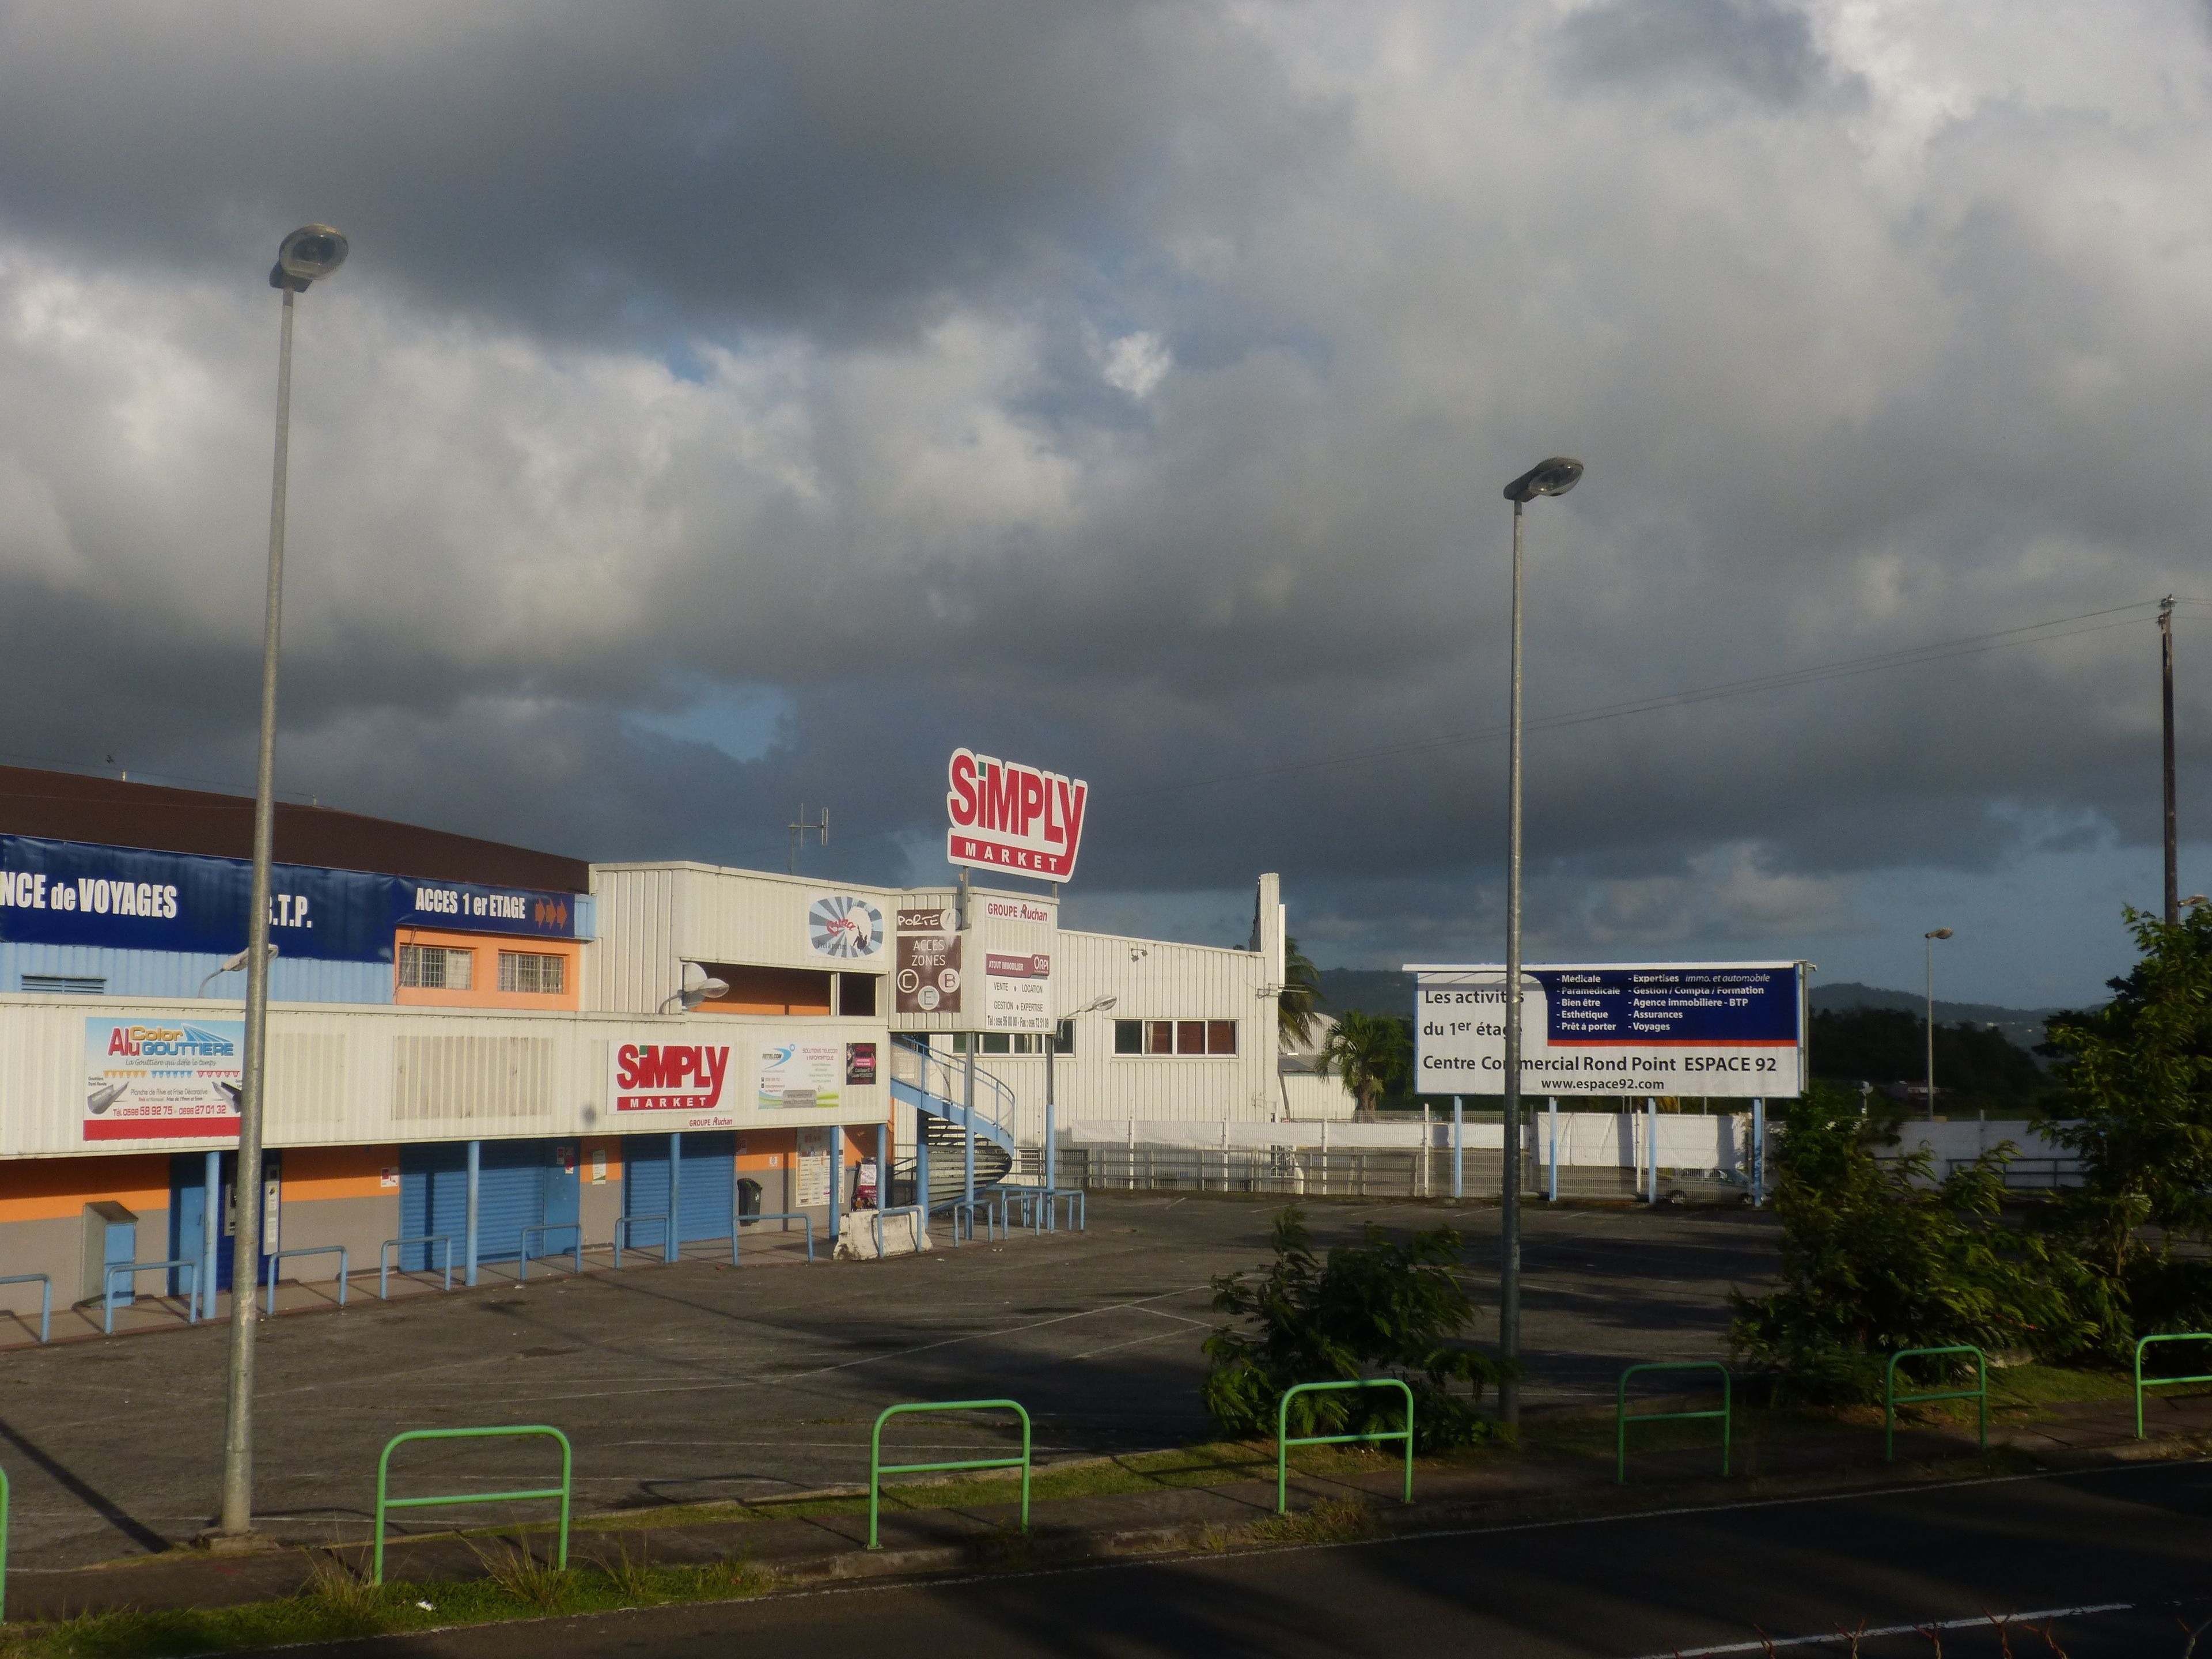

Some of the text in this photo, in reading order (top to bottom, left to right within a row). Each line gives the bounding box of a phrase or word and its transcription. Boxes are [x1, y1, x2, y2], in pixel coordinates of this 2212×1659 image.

[965, 842, 1057, 871] MARKET
[0, 871, 177, 919] NCE de VOYAGES
[415, 888, 458, 914] ACCES
[473, 897, 488, 916] er
[490, 895, 526, 919] ETAGE
[268, 894, 312, 928] .T.P.
[987, 903, 1048, 922] GROUPE Auchan
[897, 914, 940, 926] PORTE
[913, 940, 945, 950] ACCES
[911, 955, 945, 966] ZONES
[988, 960, 1001, 969] ATOUT
[903, 974, 912, 988] C
[945, 974, 956, 988] B
[1562, 975, 1601, 983] Médicale
[1634, 974, 1679, 983] Expertises
[1722, 974, 1770, 982] automobile
[994, 982, 1043, 993] VENTE LOCATION
[1562, 987, 1620, 995] Paramédicale
[1634, 986, 1667, 994] Gestion
[1675, 986, 1710, 996] Compta
[1717, 986, 1764, 994] Formation
[924, 991, 933, 1005] E
[1426, 990, 1524, 1003] Les activits
[1562, 998, 1601, 1006] Bien être
[994, 1001, 1043, 1012] GESTION EXPERTISE
[1633, 998, 1666, 1008] Agence
[1730, 998, 1748, 1006] BTP
[1562, 1010, 1608, 1020] Esthétique
[1633, 1010, 1683, 1018] Assurances
[1423, 1022, 1444, 1036] du
[1562, 1022, 1580, 1031] Prêt
[1588, 1023, 1616, 1032] porter
[1633, 1022, 1670, 1032] Voyages
[128, 1027, 184, 1041] Color
[108, 1028, 141, 1056] Alu
[165, 1059, 176, 1067] qui
[1423, 1055, 1777, 1071] Centre Comercial Rond Point ESPACE 92
[1541, 1078, 1665, 1090] www.espace92.com
[630, 1097, 706, 1108] MARKET
[140, 1106, 150, 1116] 58
[151, 1105, 161, 1116] 92
[163, 1105, 173, 1115] 75
[195, 1105, 204, 1115] 27
[206, 1105, 215, 1115] 01
[217, 1104, 226, 1115] 32
[689, 1119, 711, 1127] GROUPE
